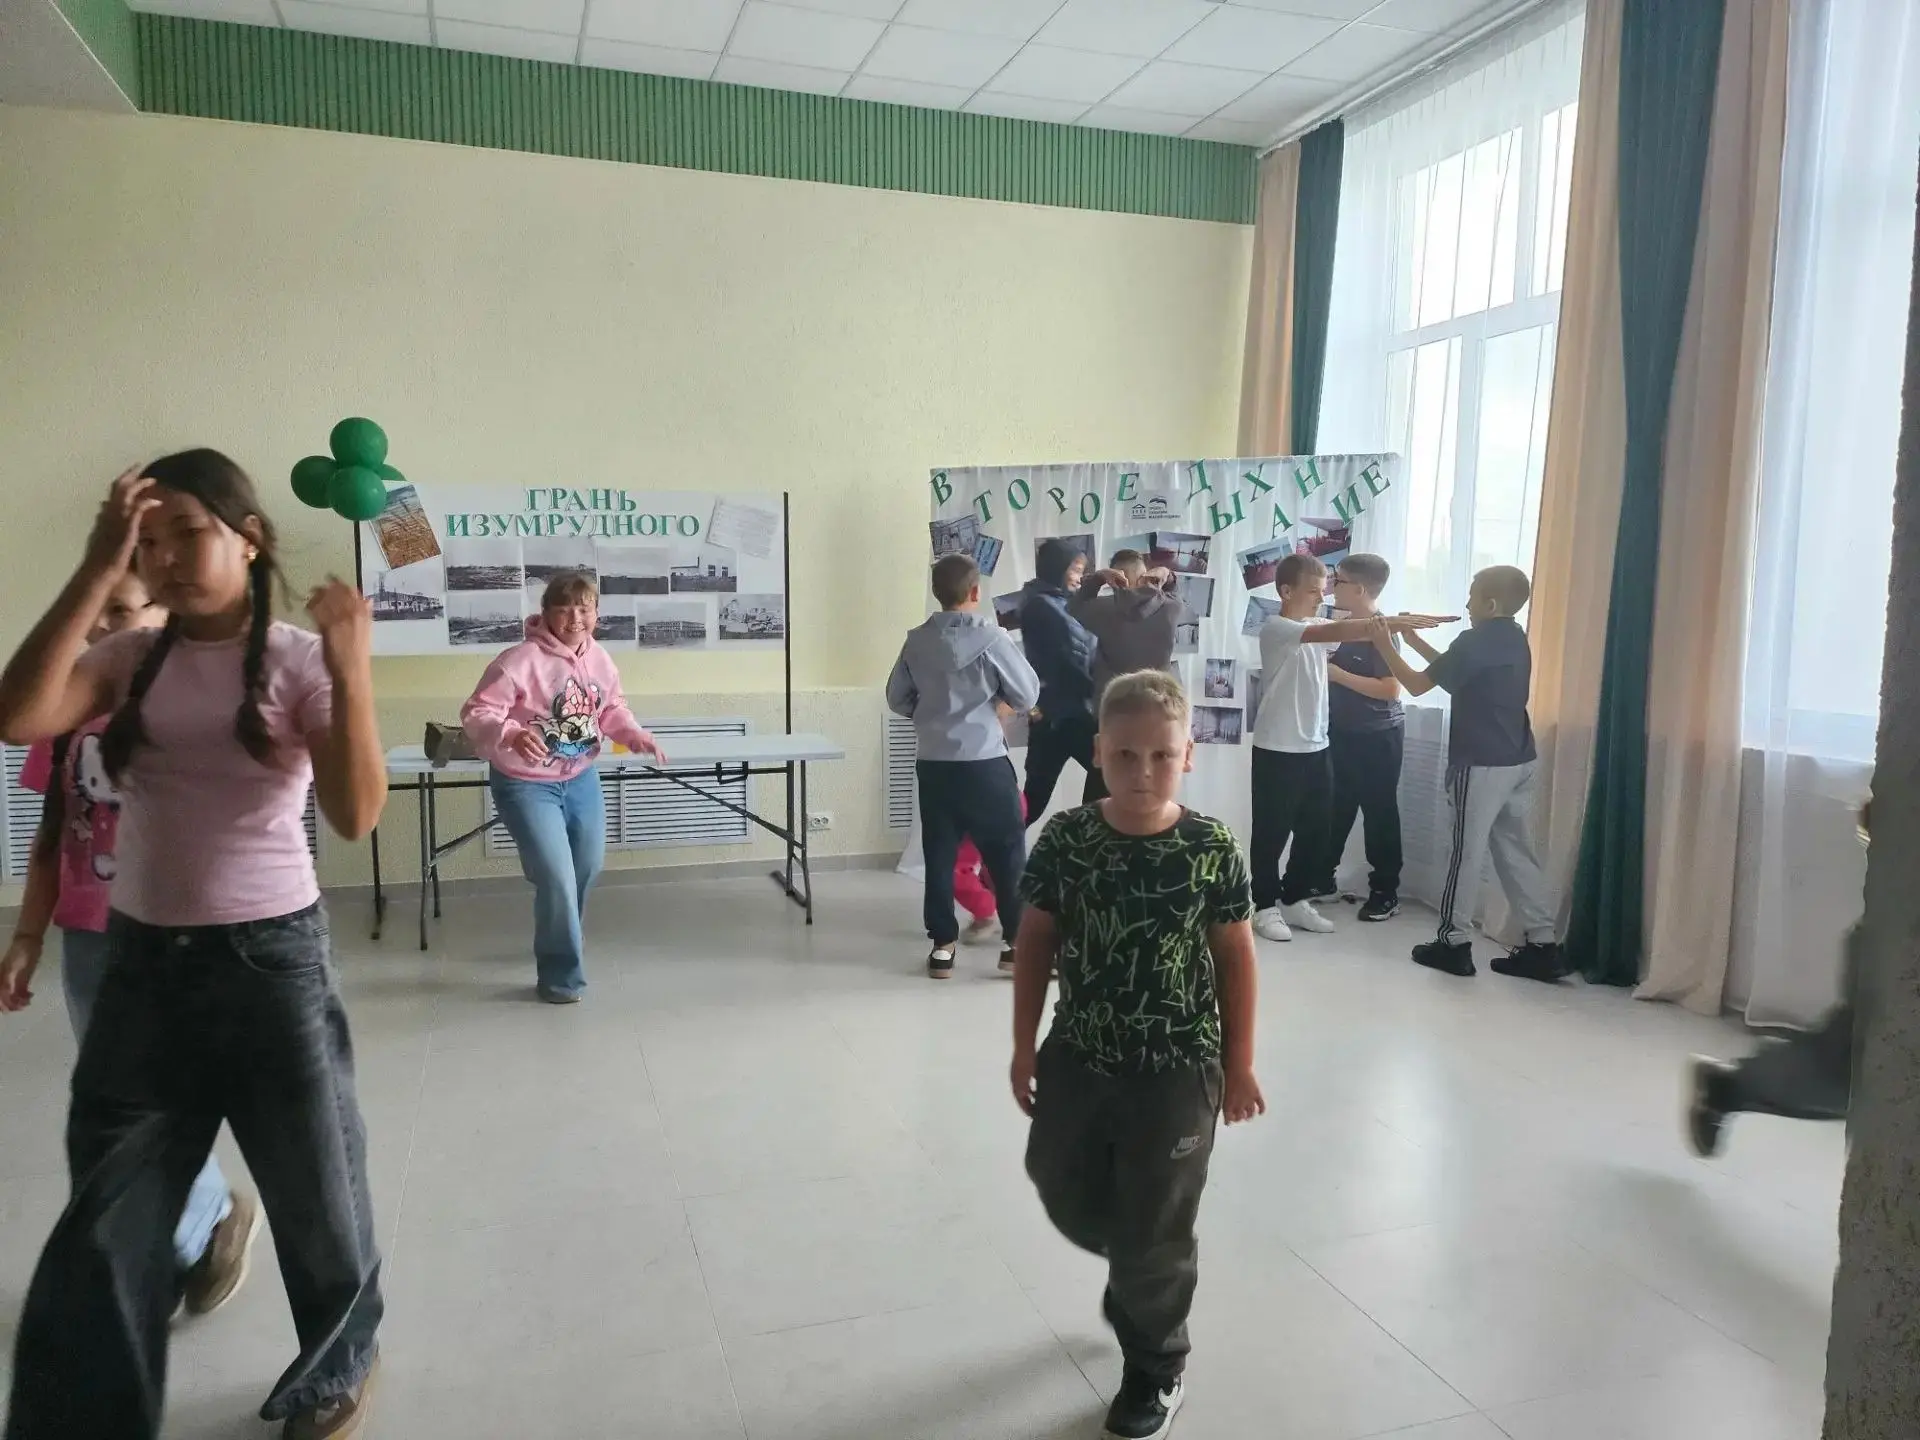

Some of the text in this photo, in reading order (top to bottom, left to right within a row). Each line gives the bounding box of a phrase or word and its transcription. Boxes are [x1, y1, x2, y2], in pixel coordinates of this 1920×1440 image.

[525, 488, 637, 512] ГРАНЬ
[929, 472, 1139, 524] ВТОРОЕ
[446, 512, 700, 538] ИЗУМРУДНОГО
